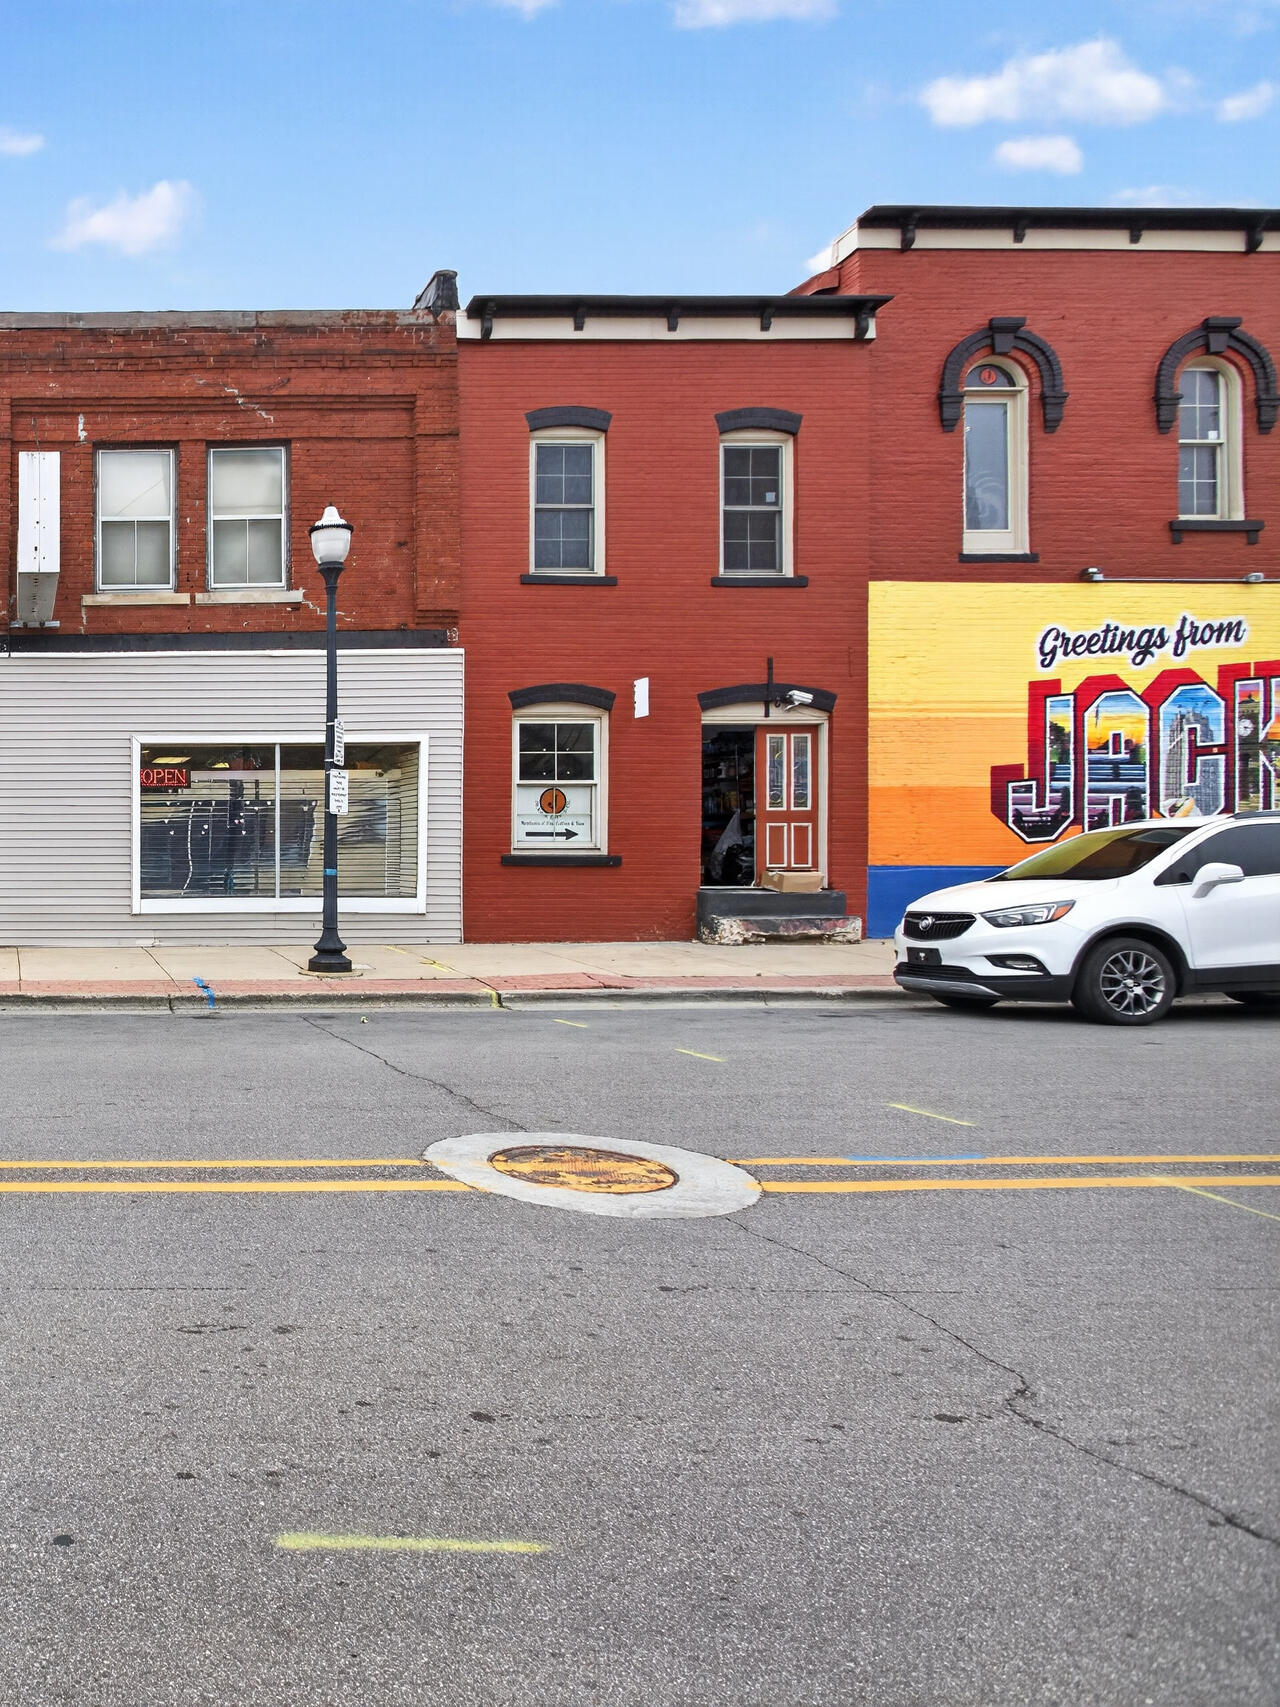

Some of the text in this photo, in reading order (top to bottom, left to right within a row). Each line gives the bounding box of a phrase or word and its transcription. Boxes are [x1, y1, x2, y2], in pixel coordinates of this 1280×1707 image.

[1038, 615, 1247, 668] Greetings from
[142, 768, 187, 785] OPEN
